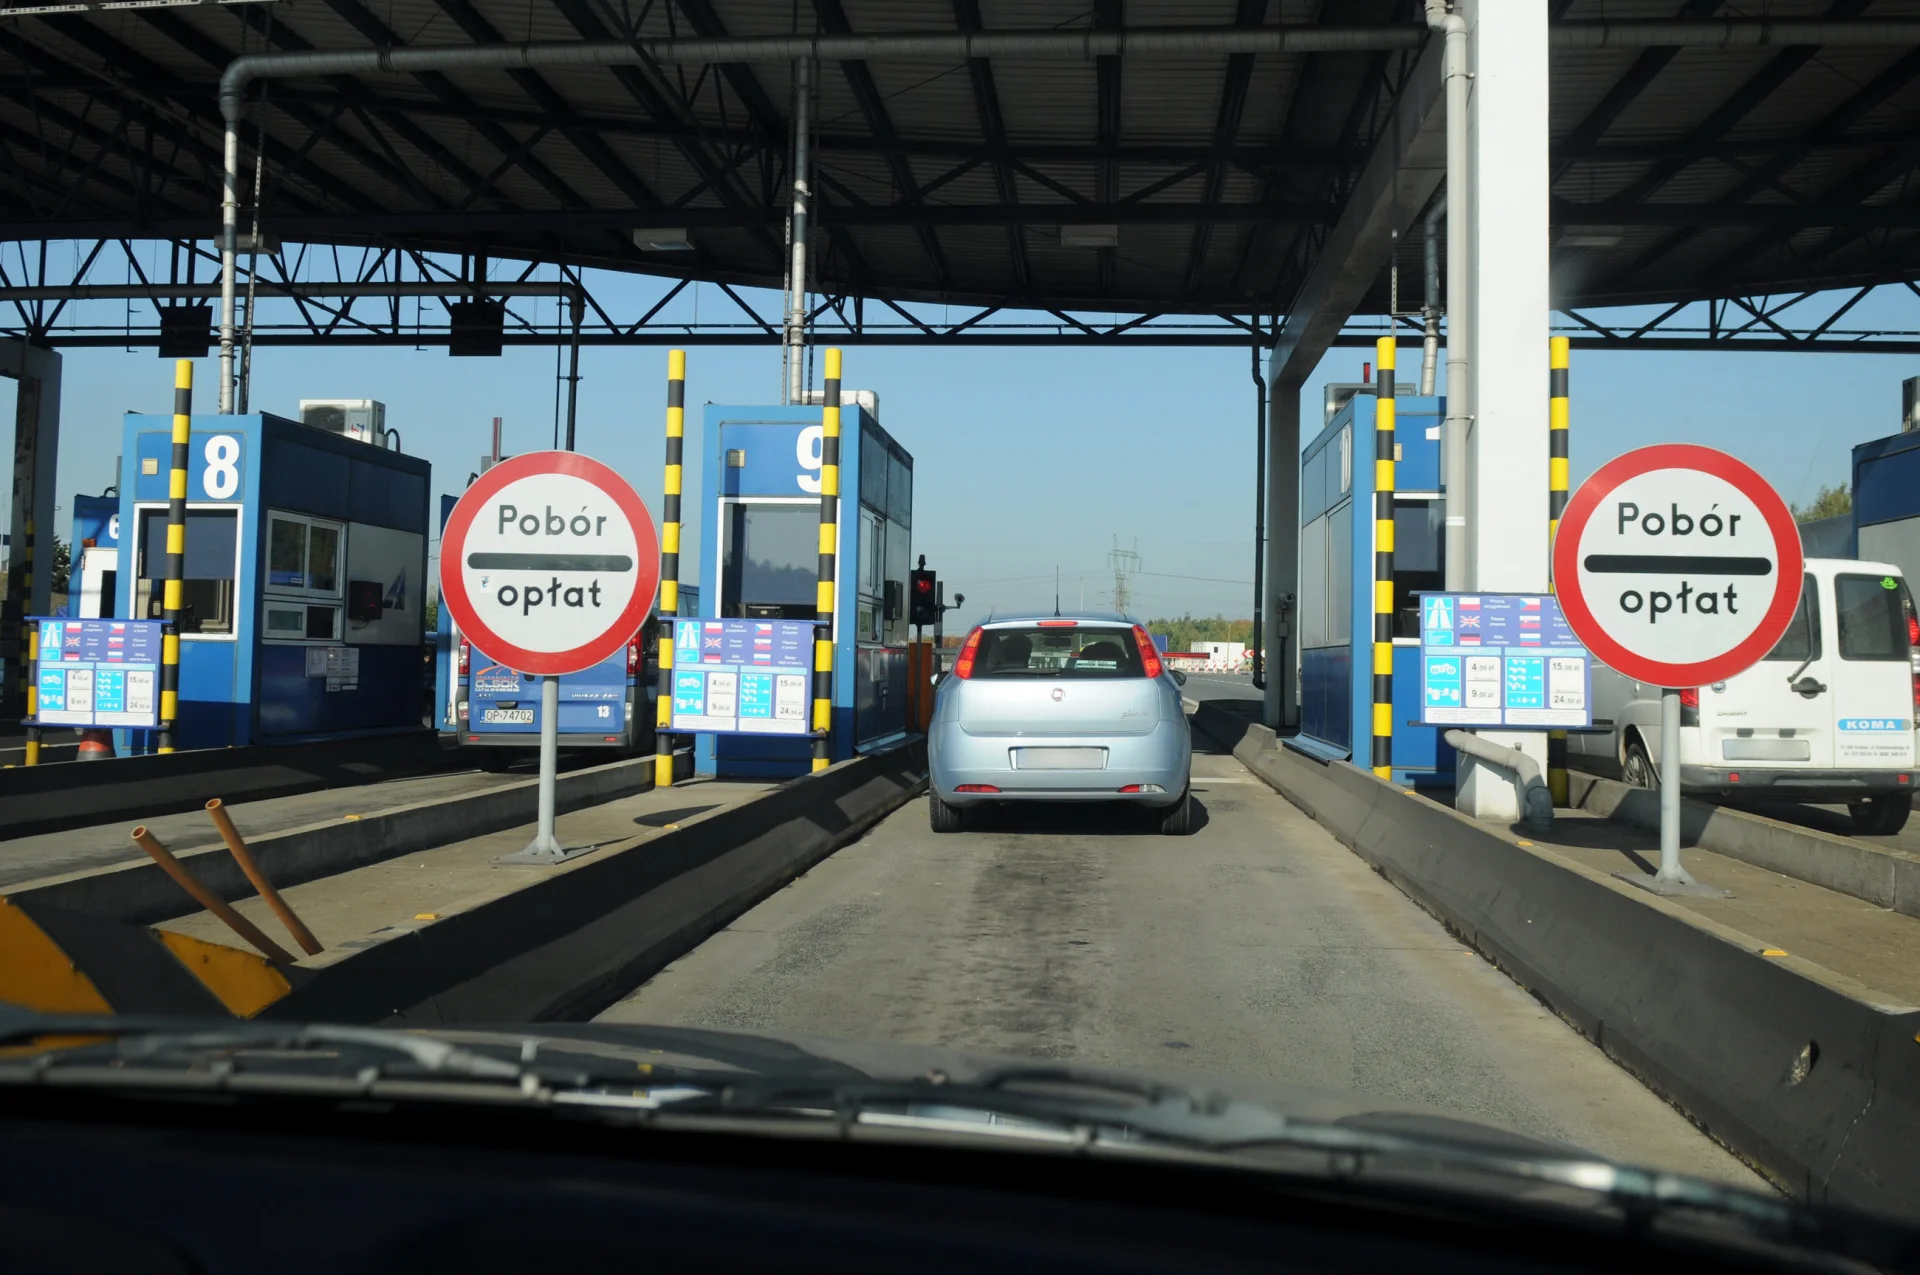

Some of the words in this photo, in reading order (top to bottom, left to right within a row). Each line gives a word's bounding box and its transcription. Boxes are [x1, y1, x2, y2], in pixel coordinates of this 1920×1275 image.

[203, 435, 240, 499] 8
[796, 425, 823, 493] 9
[108, 513, 119, 540] 6
[498, 504, 607, 536] Pobór
[1618, 502, 1741, 537] Pobór
[497, 577, 602, 616] opłat
[1619, 581, 1738, 624] opłat
[597, 705, 610, 718] 13
[1846, 720, 1897, 730] KOMA
